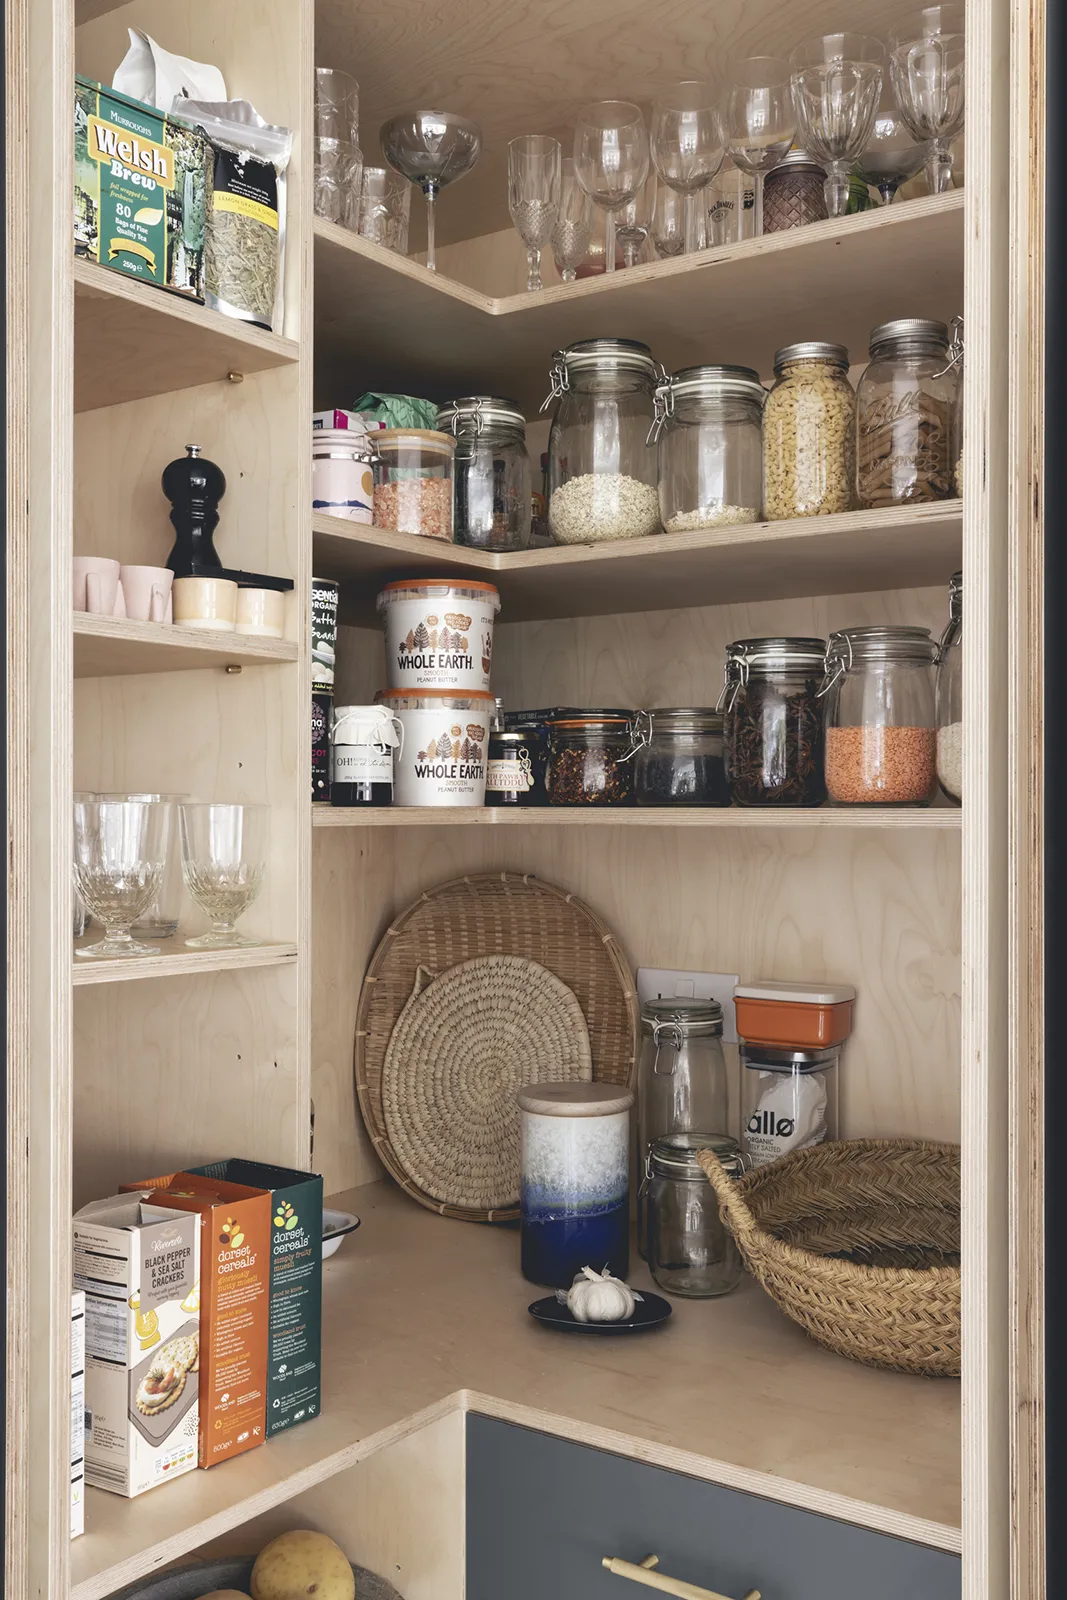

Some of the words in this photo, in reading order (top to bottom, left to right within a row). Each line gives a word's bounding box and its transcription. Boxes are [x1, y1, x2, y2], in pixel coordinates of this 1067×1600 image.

[94, 124, 168, 179] Welsh
[110, 159, 156, 191] Brew
[109, 182, 120, 190] foil
[120, 187, 140, 199] wrapped
[140, 194, 149, 202] for
[110, 190, 134, 204] freshness
[218, 196, 240, 204] LEMON
[116, 202, 132, 218] 80
[115, 217, 129, 229] Bags
[136, 224, 149, 235] Fine
[116, 226, 136, 240] Quality
[137, 233, 147, 242] Tea
[397, 654, 435, 669] WHOLE
[336, 758, 353, 766] OH!
[414, 764, 458, 778] WHOLE
[460, 764, 484, 779] EARTH
[747, 1111, 795, 1137] allø
[747, 1136, 774, 1145] ORGANIC
[273, 1227, 304, 1243] dorset
[218, 1245, 251, 1262] dorset
[273, 1237, 308, 1255] cereals
[145, 1254, 166, 1269] BLACK
[167, 1247, 191, 1262] PEPPER
[274, 1254, 295, 1264] simply
[296, 1248, 312, 1258] fruity
[152, 1268, 156, 1278] &
[158, 1265, 170, 1276] SEA
[171, 1260, 185, 1272] SALT
[218, 1255, 255, 1274] cereals
[274, 1261, 294, 1272] muesli
[152, 1270, 184, 1288] CRACKERS
[218, 1282, 236, 1292] nutty
[238, 1274, 258, 1286] muesli
[272, 1290, 284, 1298] good
[217, 1312, 229, 1321] good
[272, 1327, 295, 1338] woodland
[239, 1351, 251, 1360] trust
